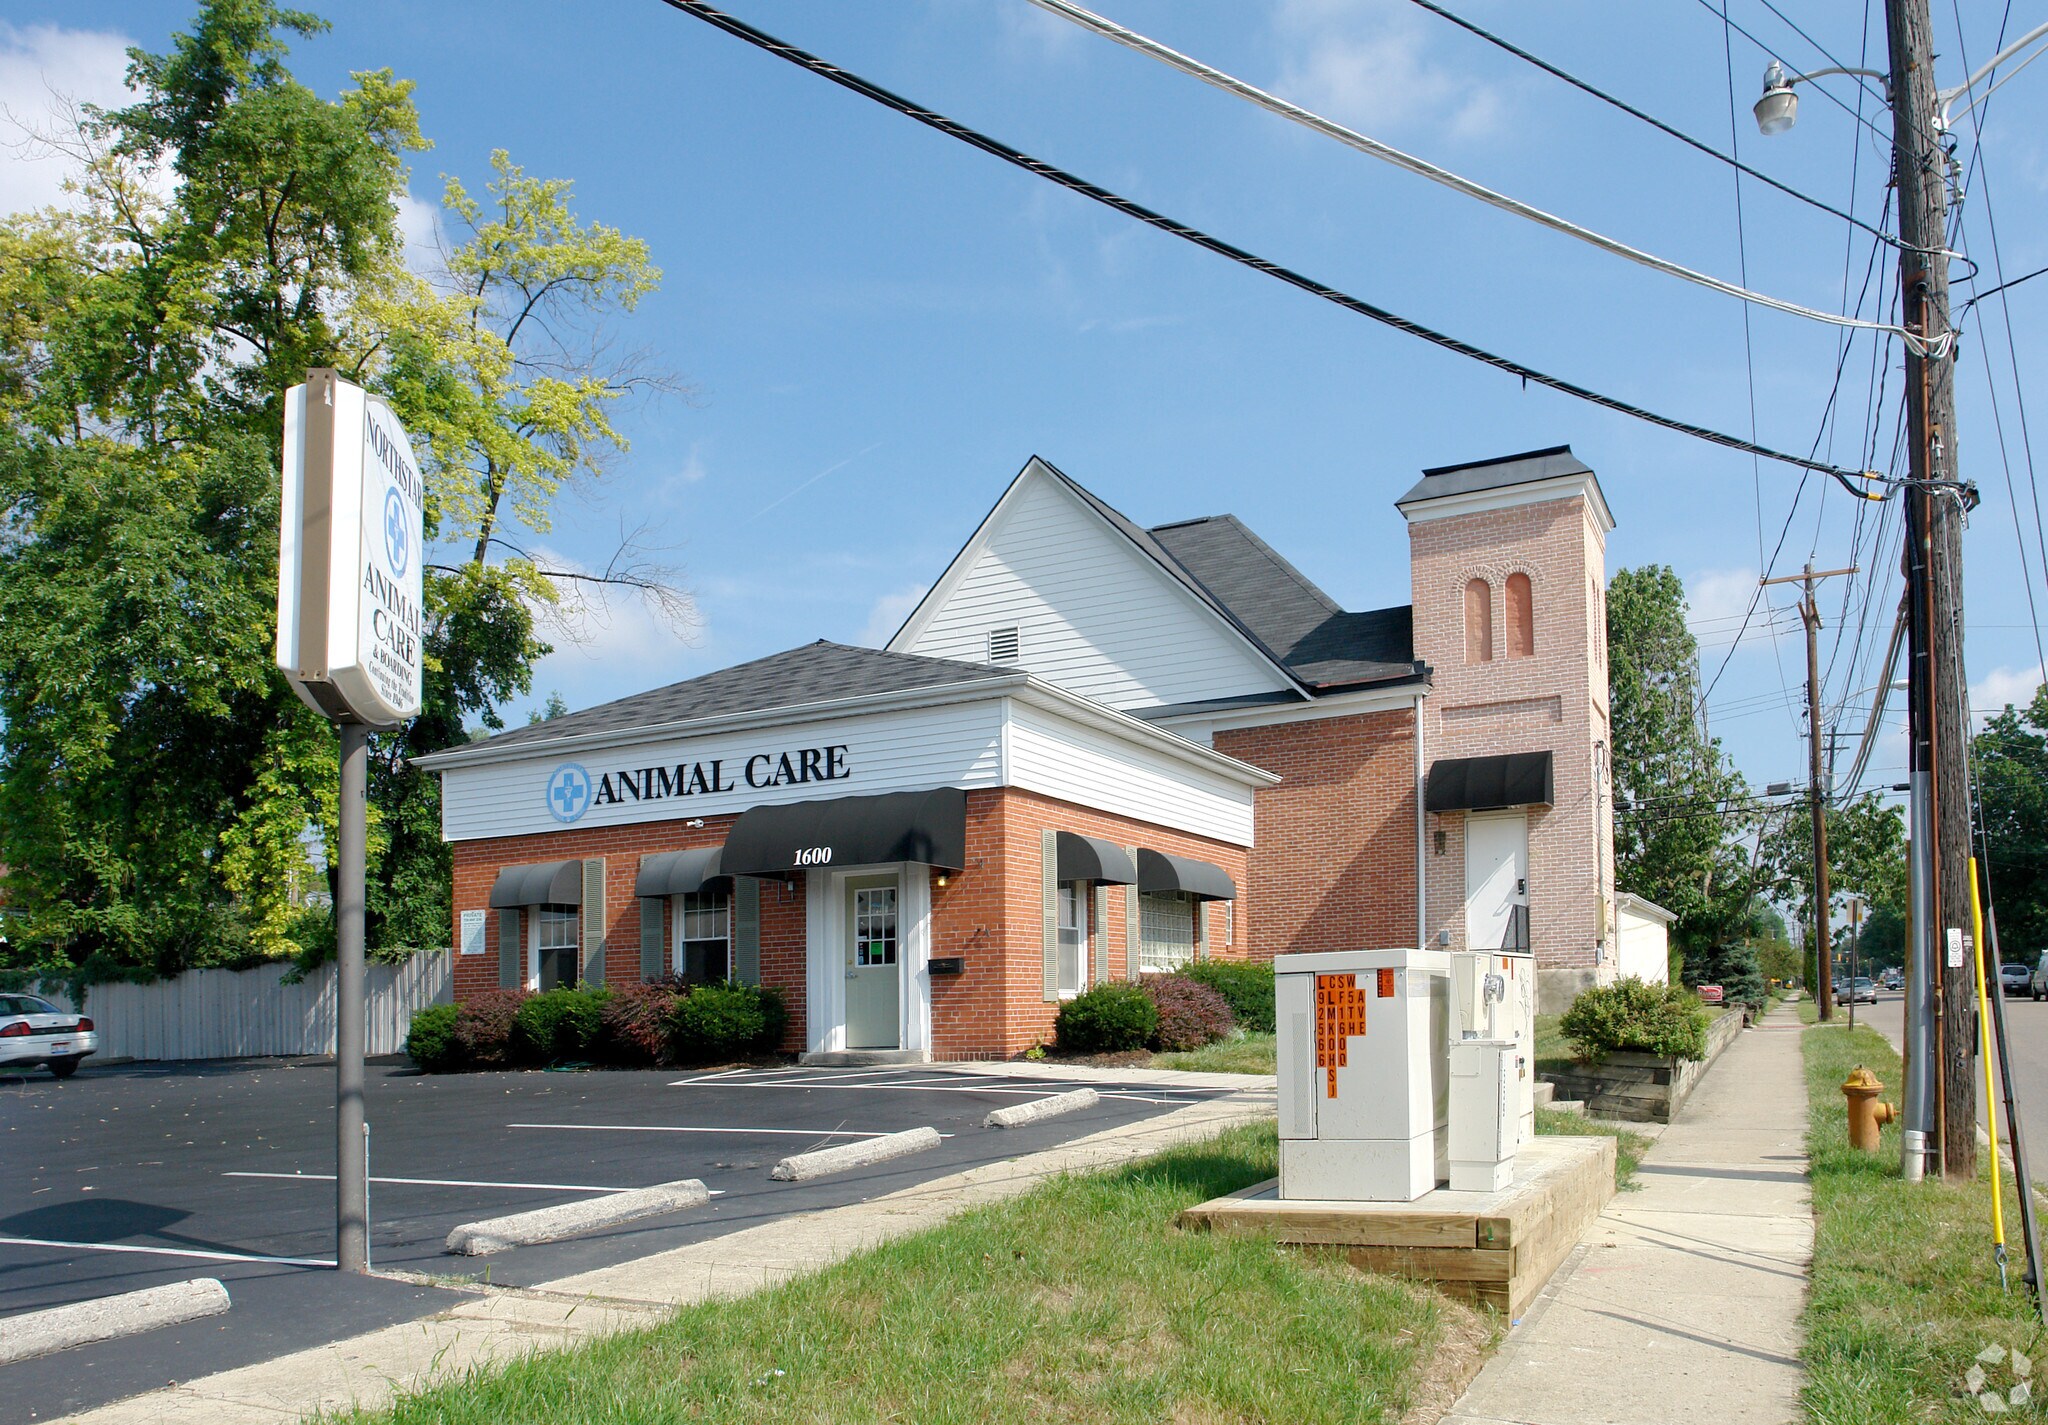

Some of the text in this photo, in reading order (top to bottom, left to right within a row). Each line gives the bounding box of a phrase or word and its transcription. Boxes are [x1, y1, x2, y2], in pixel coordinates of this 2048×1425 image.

[366, 409, 423, 514] NORTHSTAR
[363, 561, 422, 640] ANIMAL
[372, 643, 413, 686] & BOARDING
[373, 608, 416, 668] CARE
[593, 744, 851, 806] ANIMAL CARE
[793, 846, 833, 866] 1600
